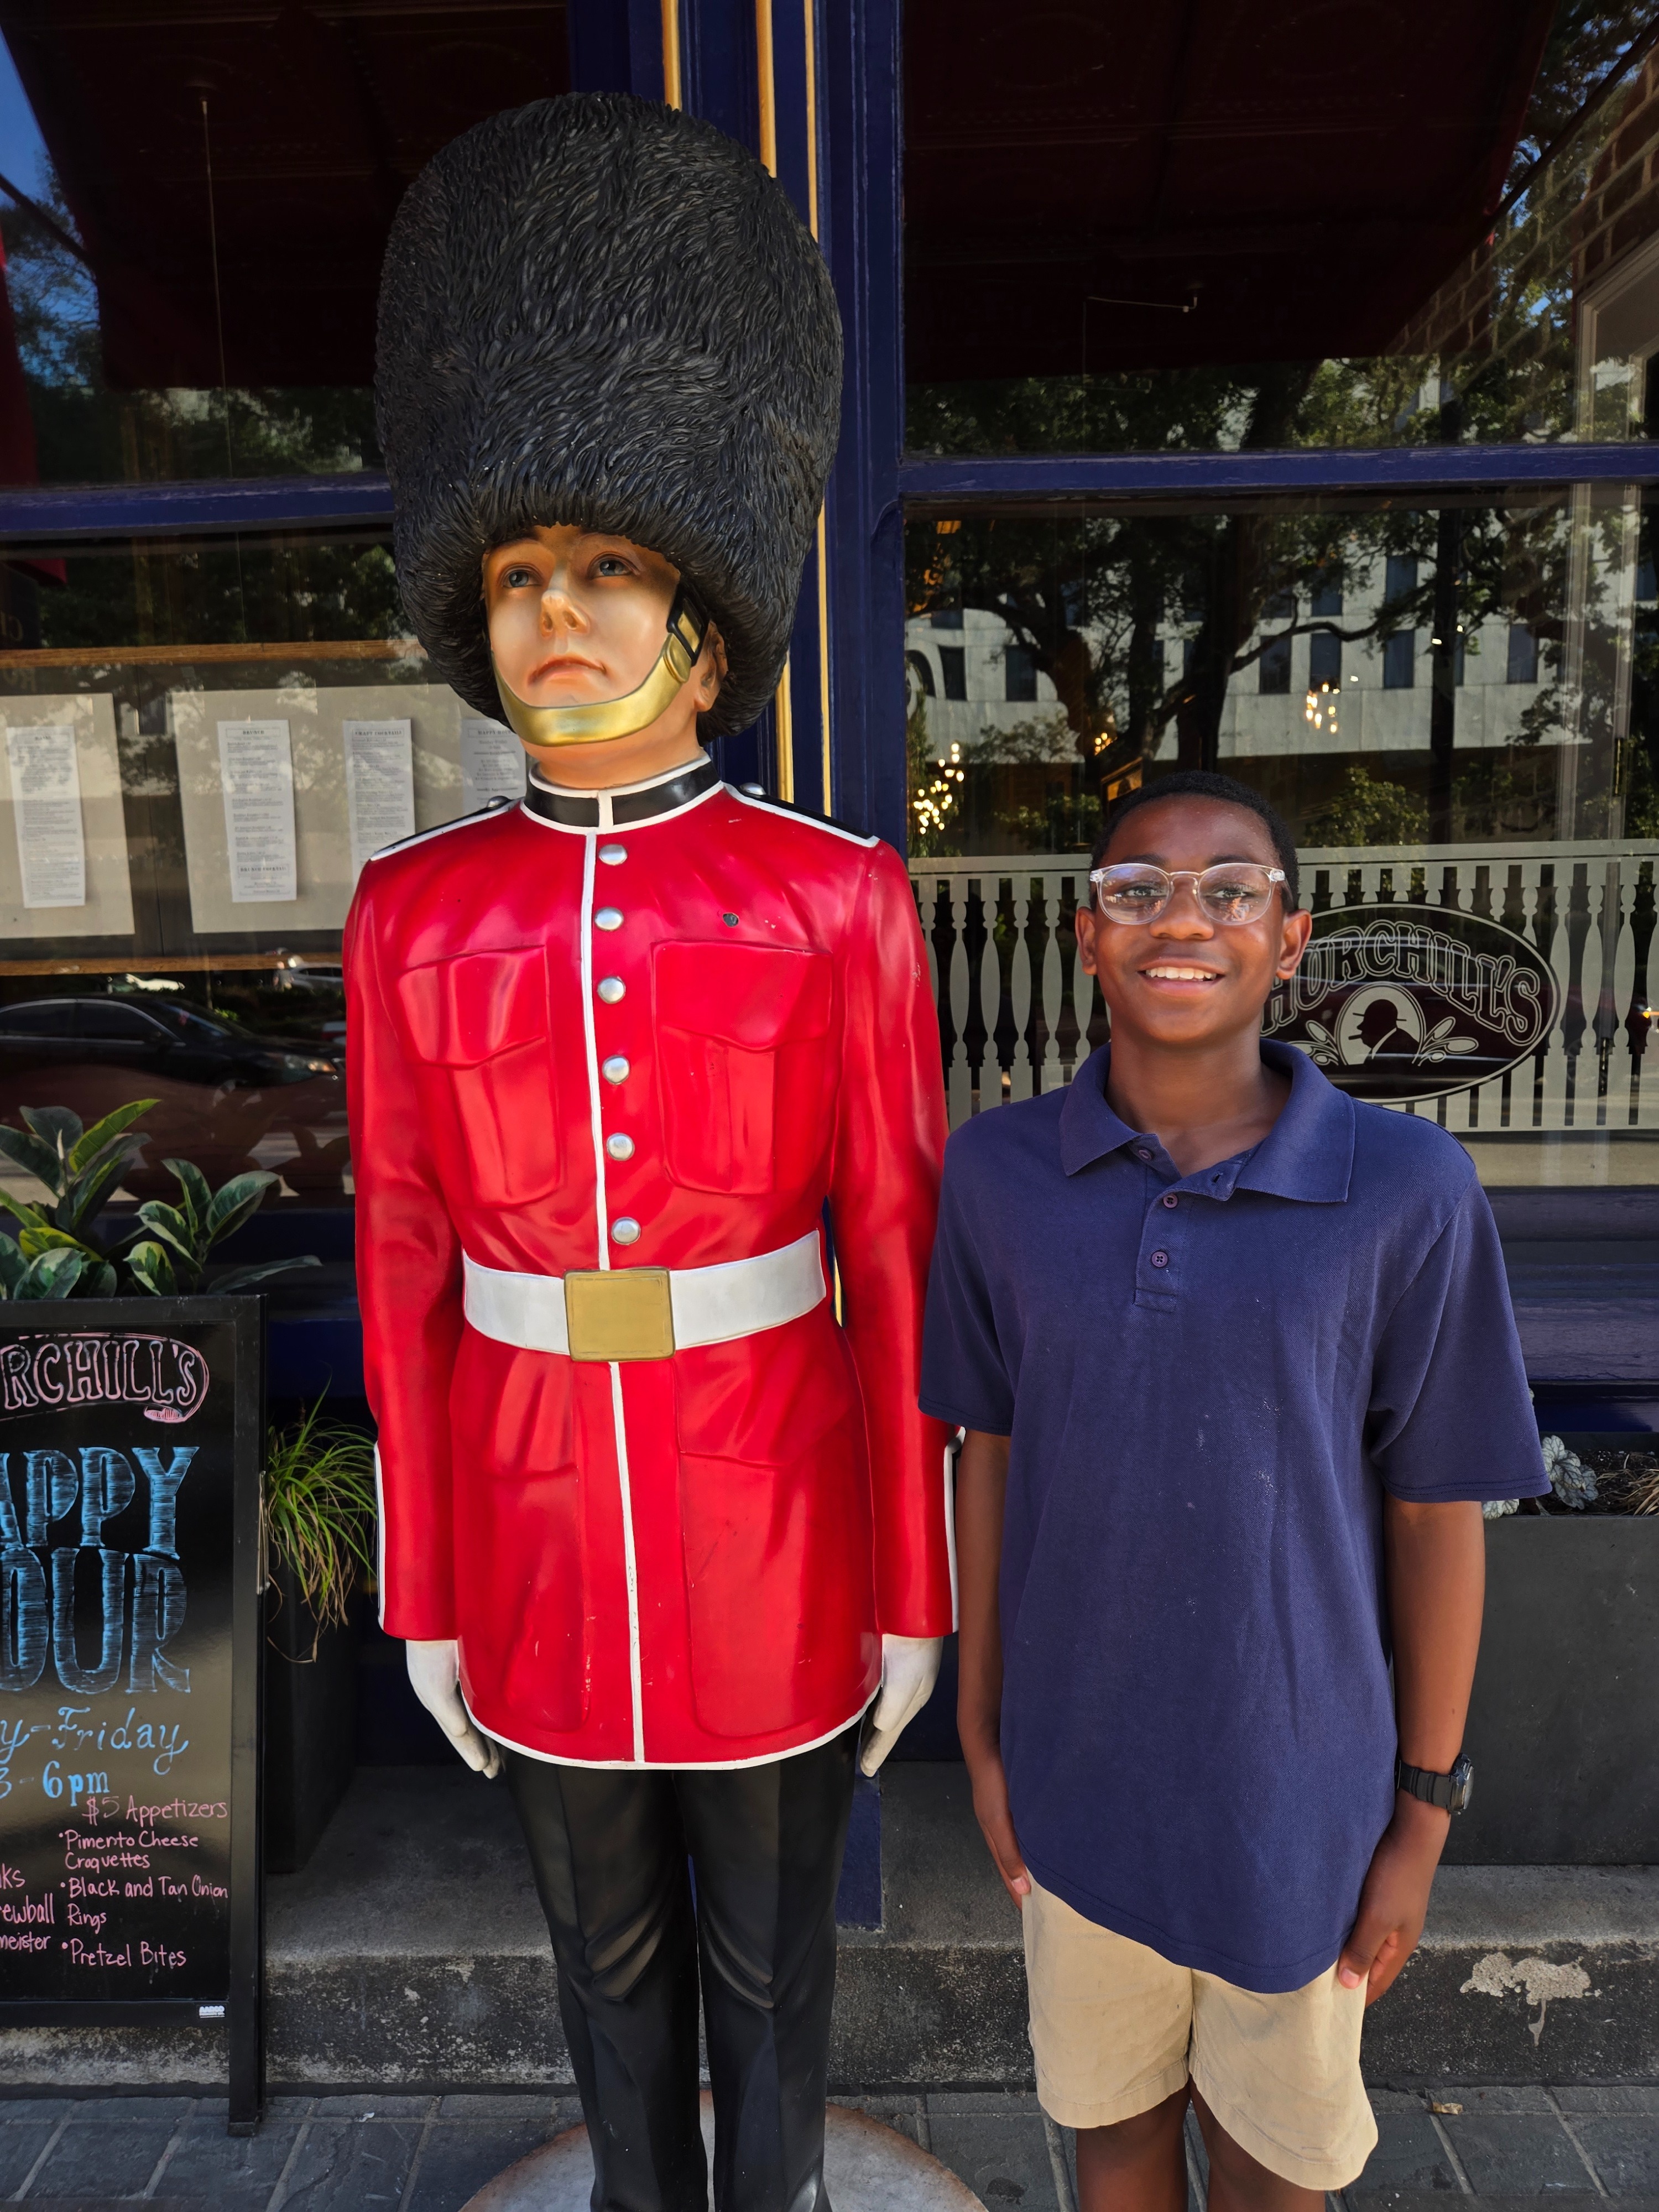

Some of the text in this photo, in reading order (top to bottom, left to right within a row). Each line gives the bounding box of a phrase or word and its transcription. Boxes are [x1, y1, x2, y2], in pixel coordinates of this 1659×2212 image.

[1260, 919, 1542, 1046] HURCHILL'S
[82, 1795, 228, 1827] $5 Appetizers
[64, 1829, 199, 1850] Pimento Cheese
[0, 1863, 25, 1890] ks
[65, 1852, 150, 1874] Croquettes
[69, 1874, 228, 1898] Black and Tan Onion
[0, 1892, 55, 1924] ewball
[67, 1903, 107, 1934] Rings
[70, 1938, 186, 1968] Pretzel Bites
